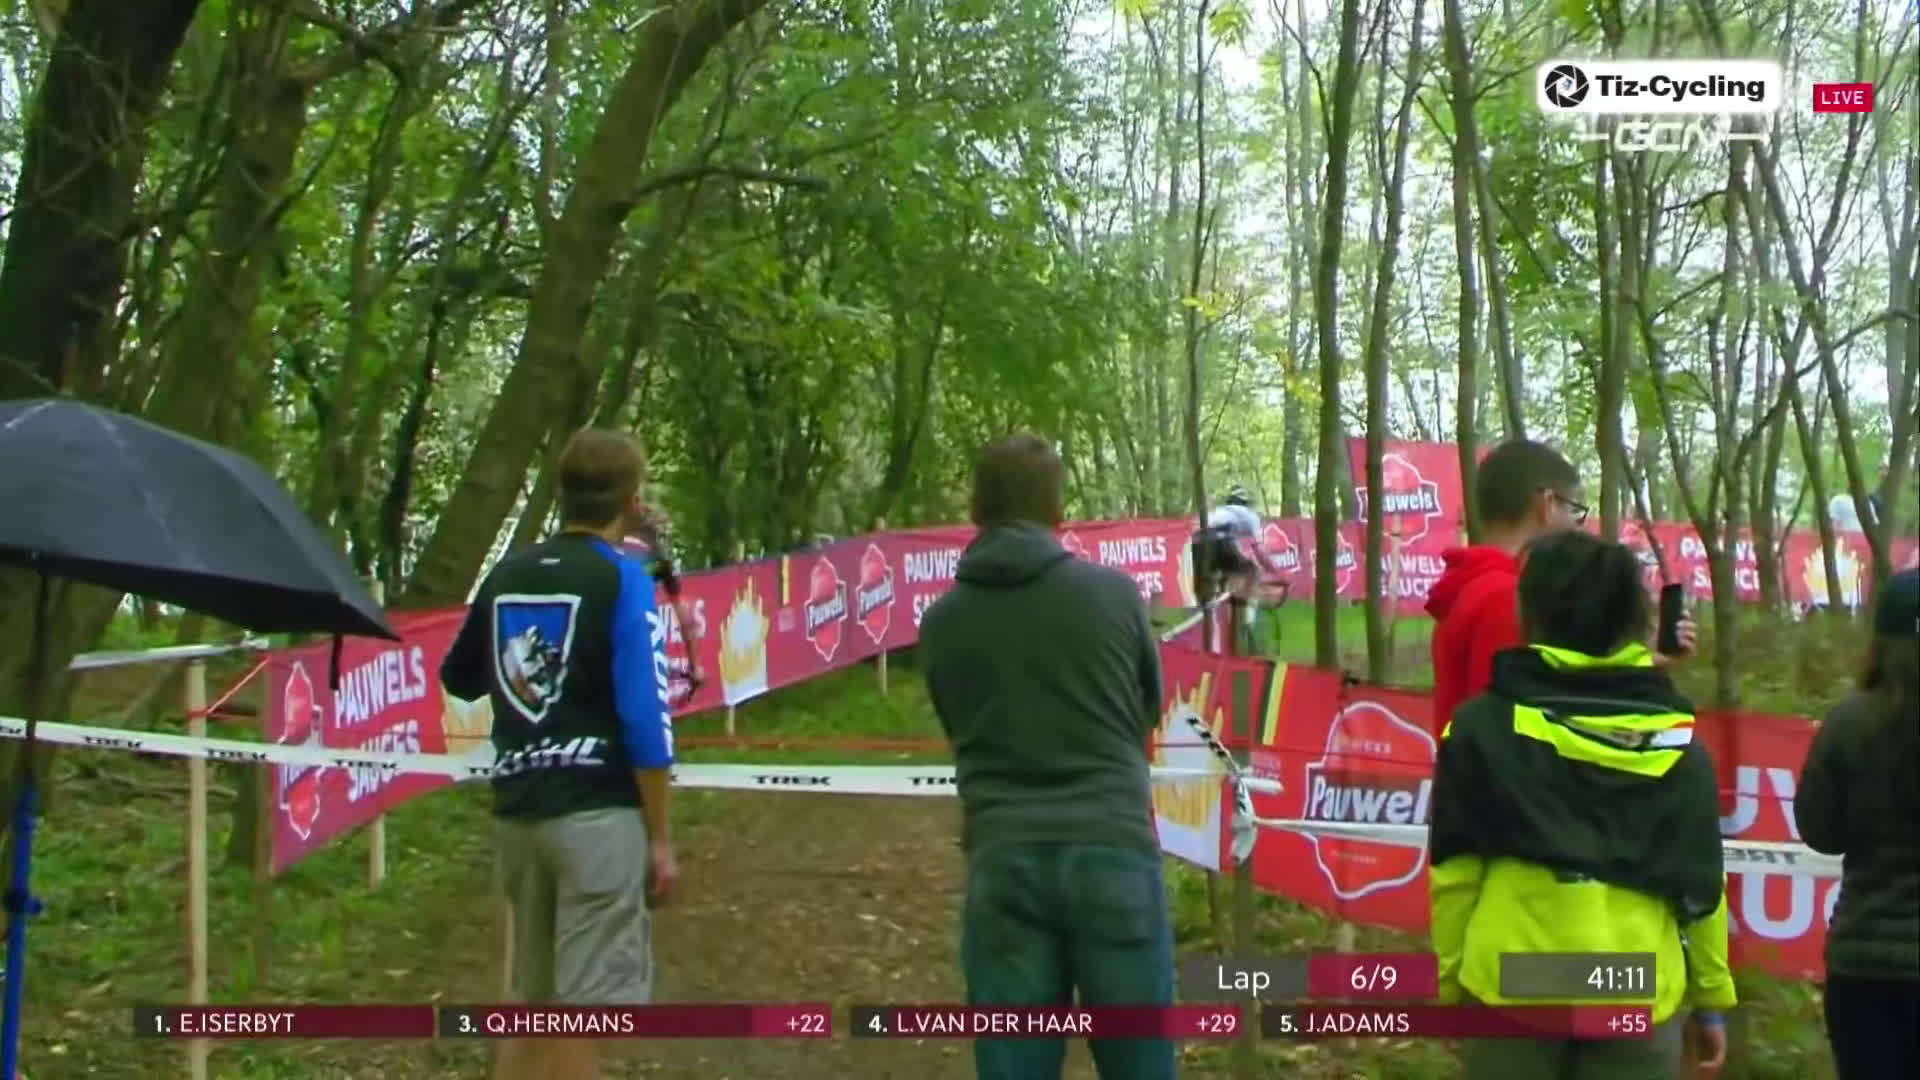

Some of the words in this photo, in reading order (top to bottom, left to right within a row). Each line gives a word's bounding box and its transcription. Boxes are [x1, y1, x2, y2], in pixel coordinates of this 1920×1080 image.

[904, 550, 961, 583] PAUWE
[1099, 536, 1167, 566] PAUWELS
[334, 647, 427, 729] PAUWELS
[1310, 775, 1433, 825] Pauwel
